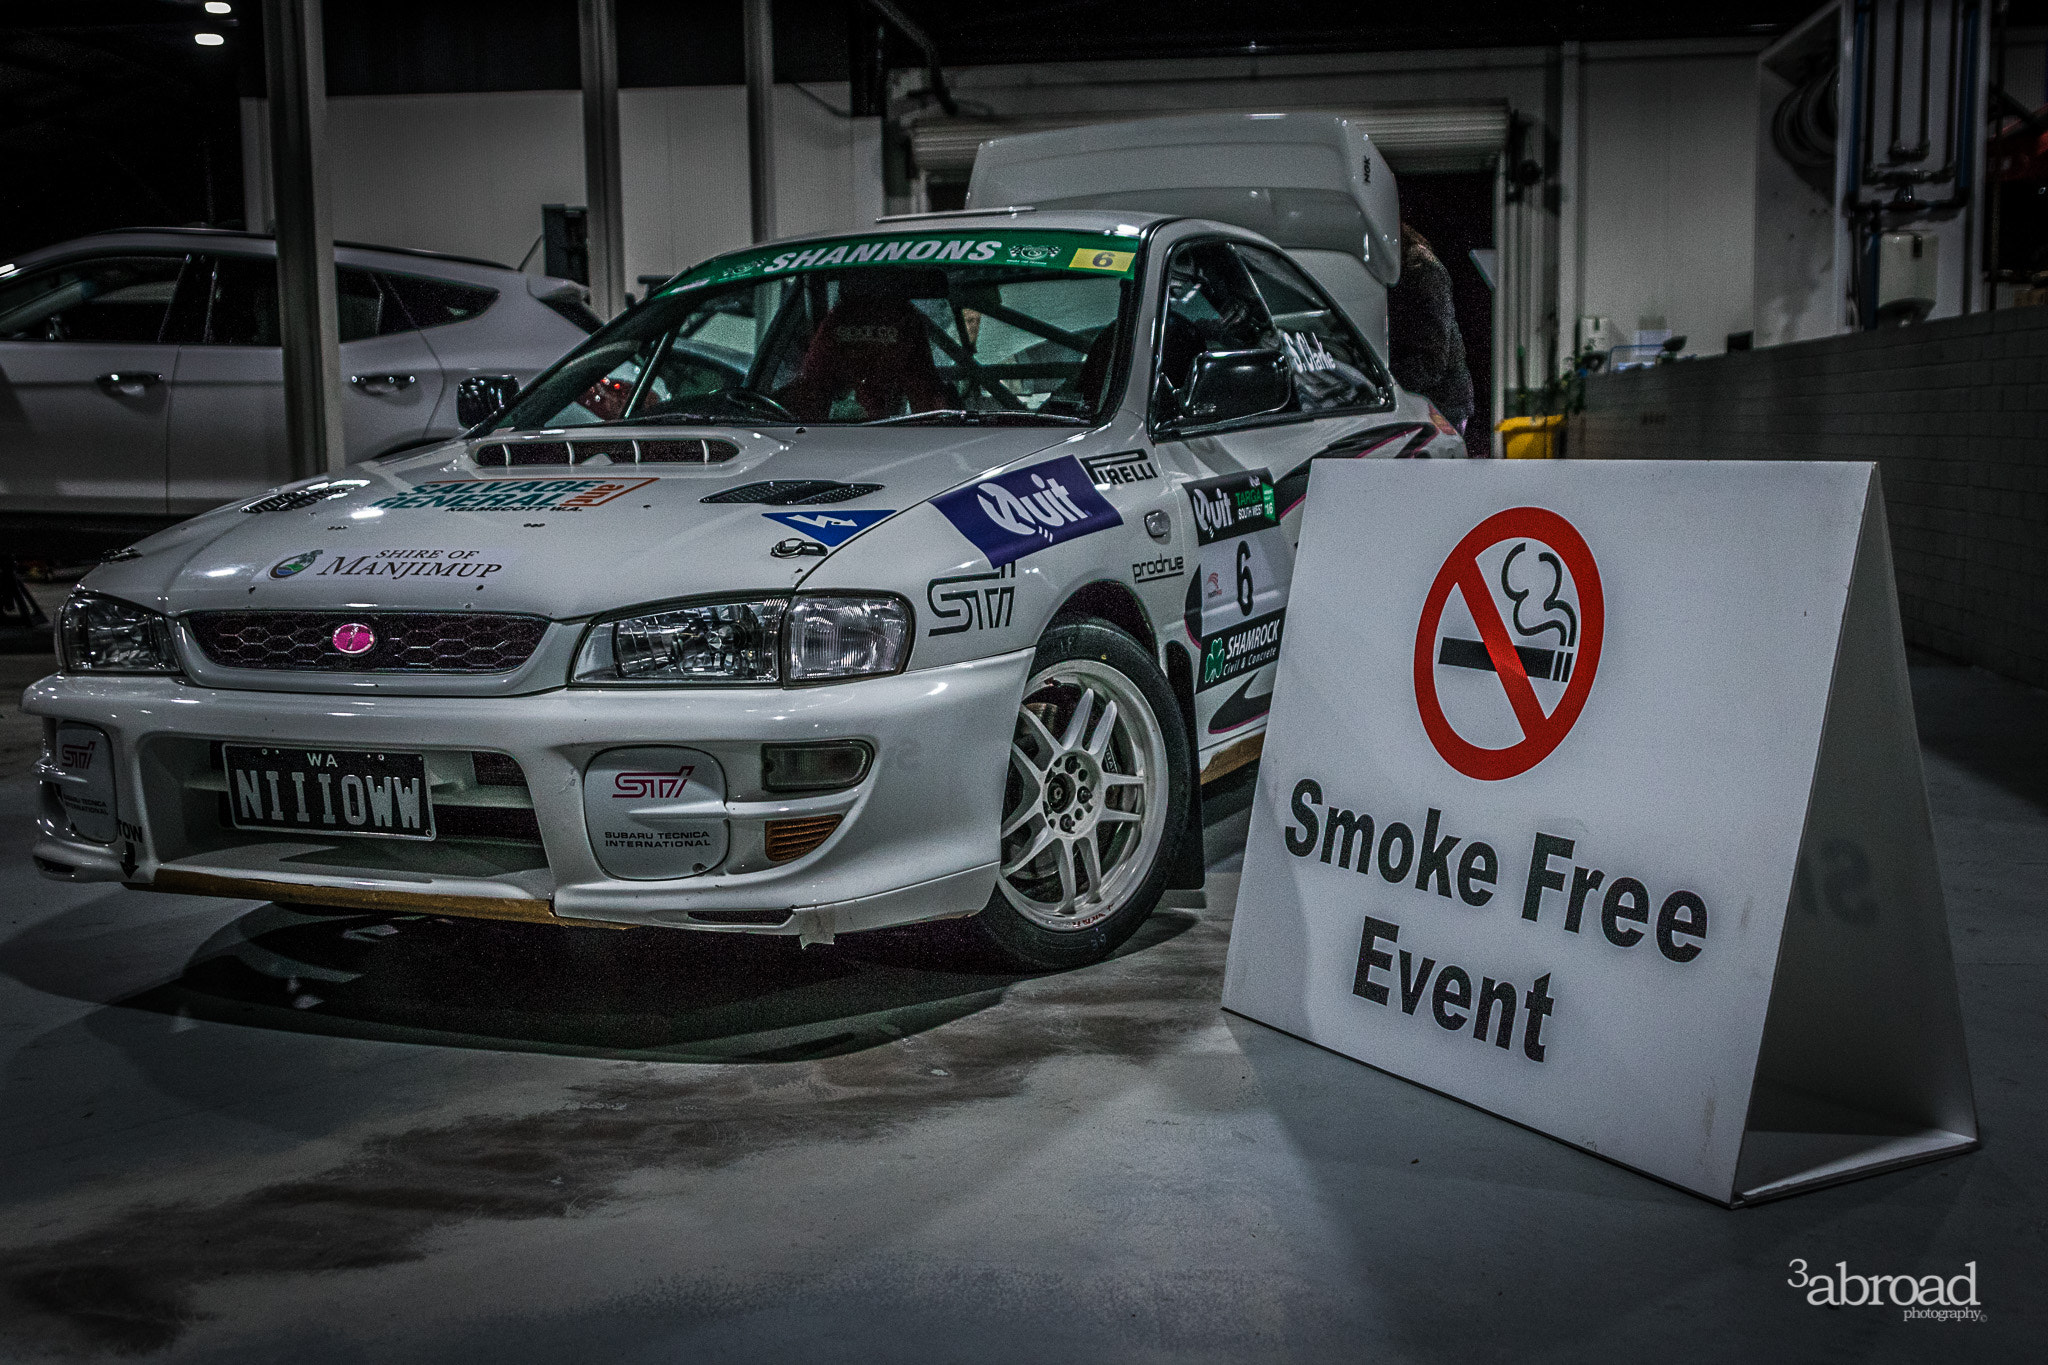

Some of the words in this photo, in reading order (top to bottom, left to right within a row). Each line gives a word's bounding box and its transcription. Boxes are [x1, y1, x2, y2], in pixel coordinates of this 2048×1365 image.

[763, 240, 1003, 273] SHANNONS
[1091, 251, 1115, 269] 6
[1079, 448, 1159, 486] PIRELLI
[368, 493, 566, 509] GENERAL
[398, 480, 605, 496] SALVAGE
[1235, 489, 1262, 506] TARGA
[977, 474, 1088, 536] Quit
[1193, 488, 1233, 531] Quit
[316, 555, 502, 580] MANJIMUP
[375, 549, 443, 559] SHIRE
[446, 549, 480, 559] OF
[1132, 553, 1184, 584] prodrive
[1236, 540, 1255, 617] 6
[1226, 619, 1280, 660] SHAMROCK
[1223, 659, 1240, 676] Civil
[1247, 647, 1277, 666] Concrete
[306, 753, 338, 768] WA
[117, 819, 143, 843] TOW
[605, 831, 654, 839] SUBARU
[656, 831, 710, 839] TECNICA
[605, 839, 711, 848] INTERNATIONAL
[1283, 778, 1499, 907] Smoke
[1520, 831, 1709, 963] Free
[1352, 915, 1555, 1063] Event
